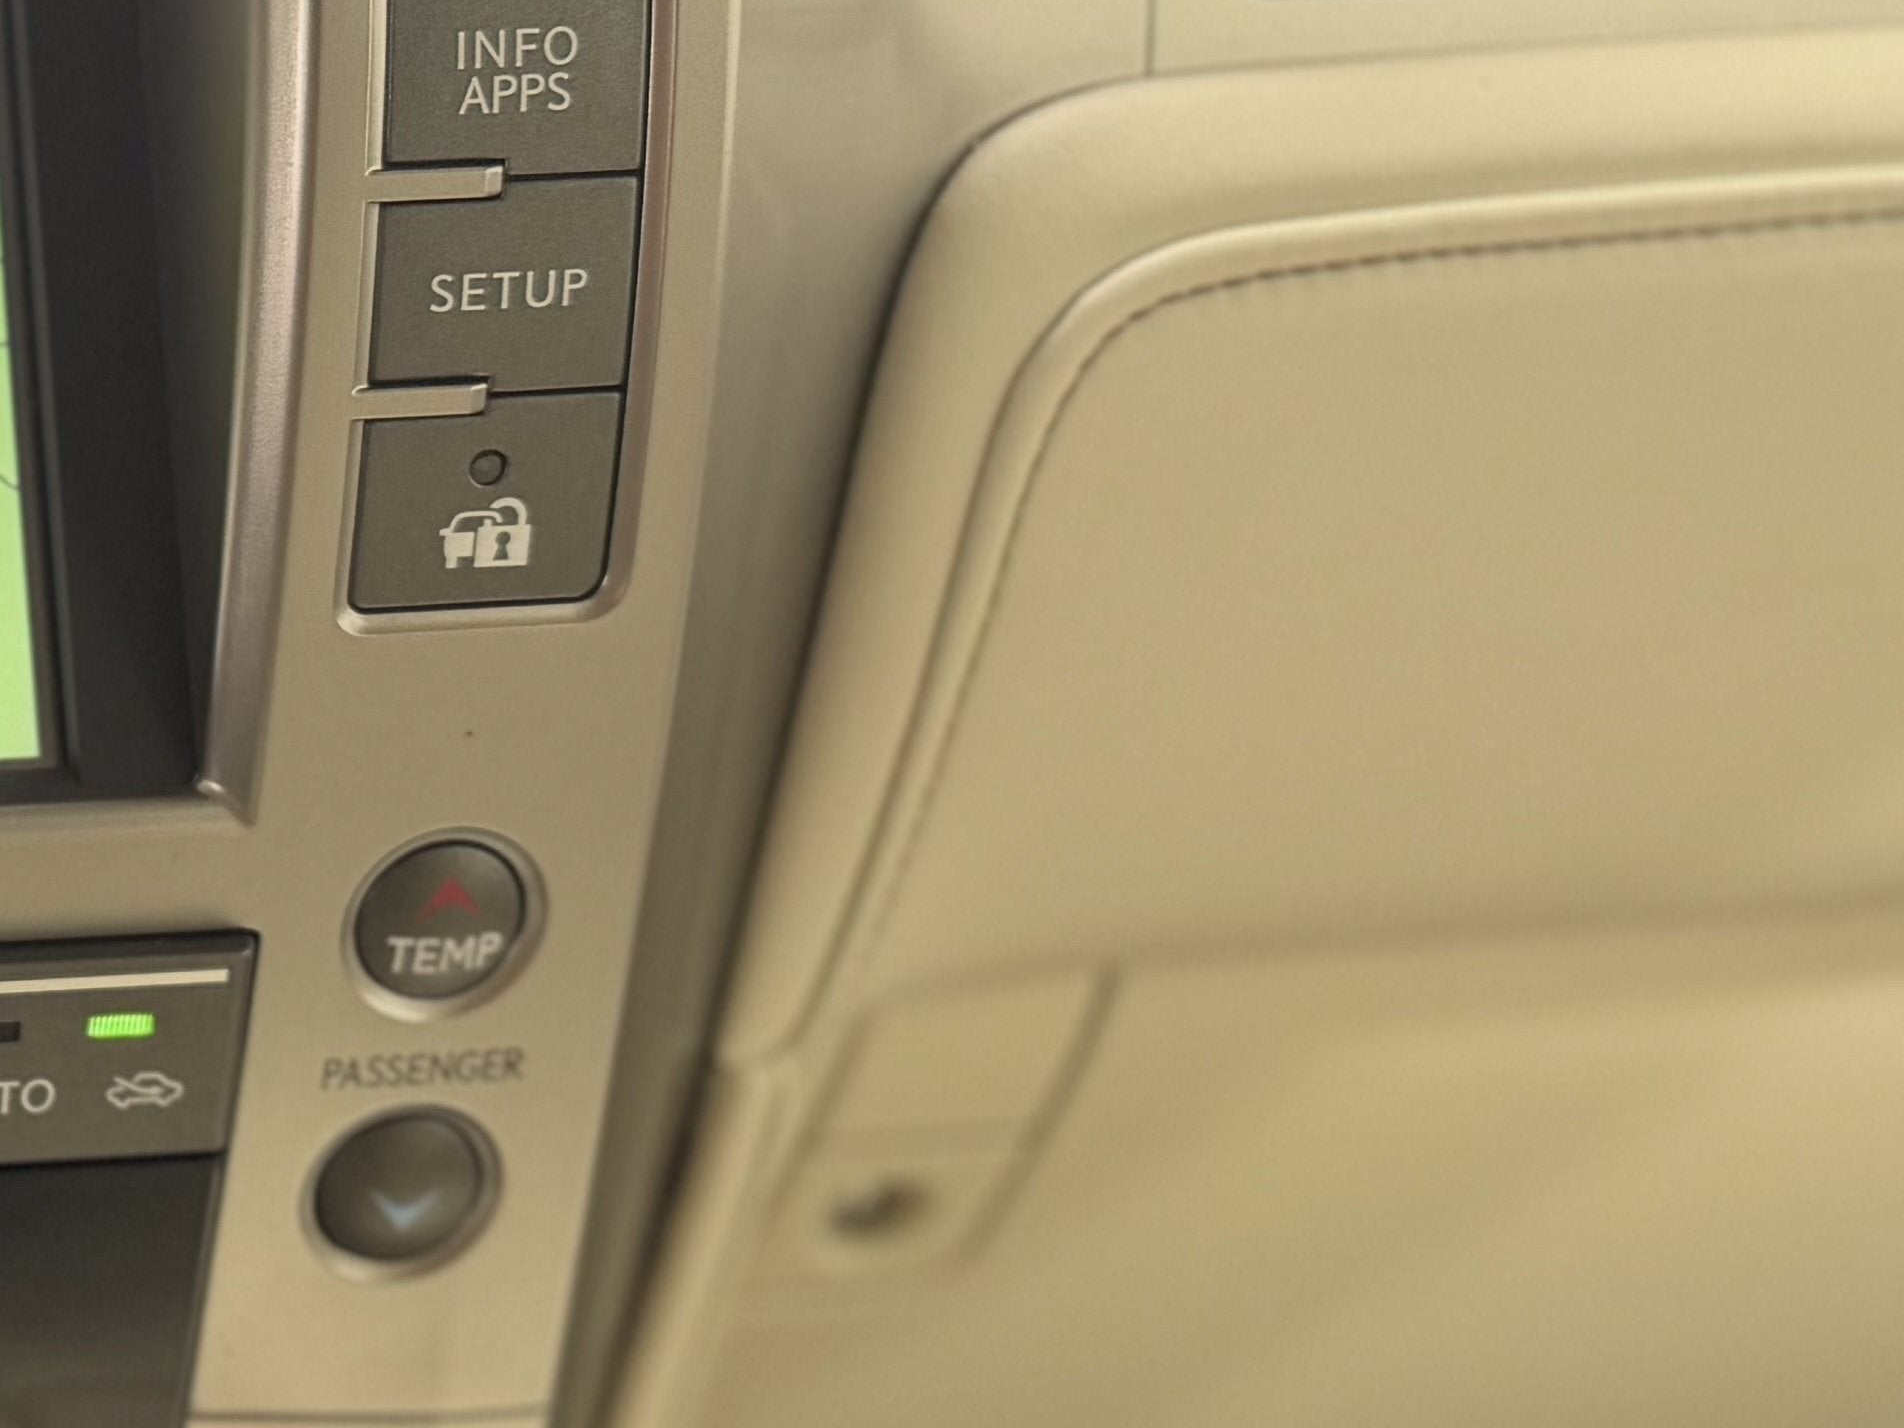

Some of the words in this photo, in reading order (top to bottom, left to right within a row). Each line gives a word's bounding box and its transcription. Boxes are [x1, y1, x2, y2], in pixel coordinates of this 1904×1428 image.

[455, 25, 578, 69] INFO
[458, 73, 572, 116] APPS
[429, 269, 588, 312] SETUP
[387, 931, 503, 974] TEMP
[319, 1046, 525, 1090] PASSENGER
